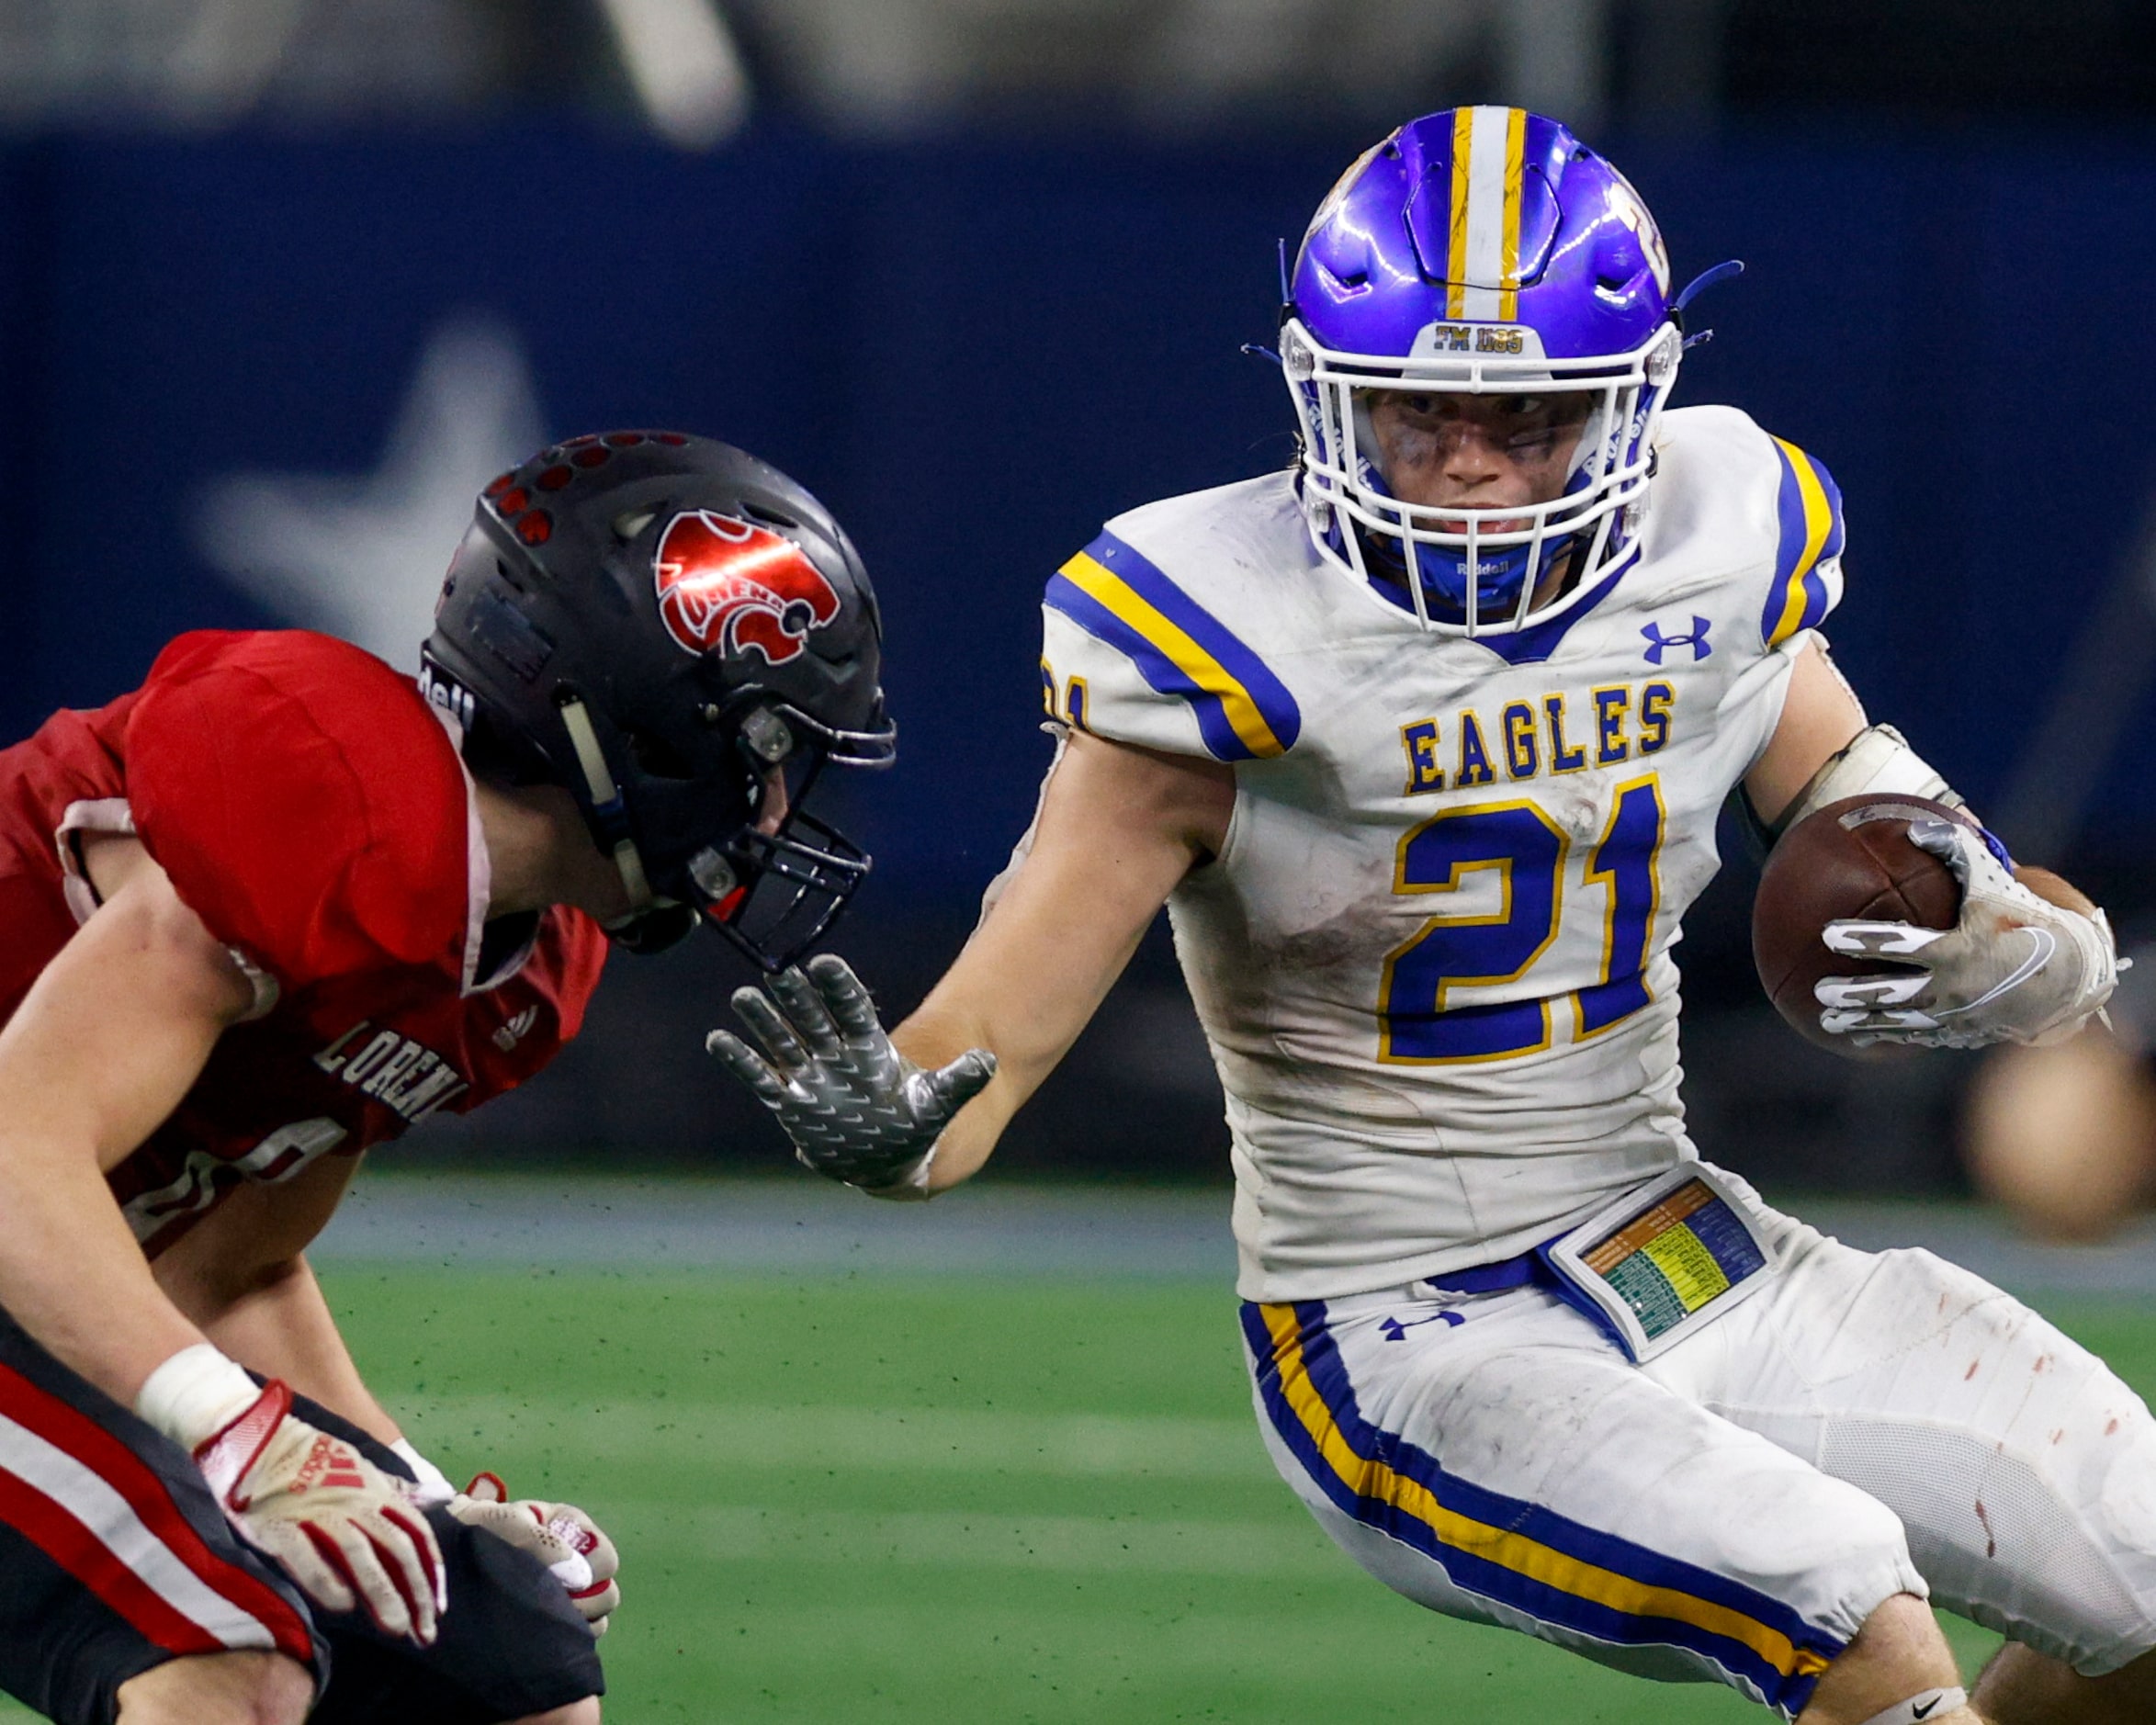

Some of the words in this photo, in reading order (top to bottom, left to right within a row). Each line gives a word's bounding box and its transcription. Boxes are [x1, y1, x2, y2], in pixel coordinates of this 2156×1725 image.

[1434, 325, 1470, 351] FM
[1475, 328, 1523, 354] 1189
[1398, 679, 1676, 796] EAGLES
[1377, 771, 1667, 1065] 21
